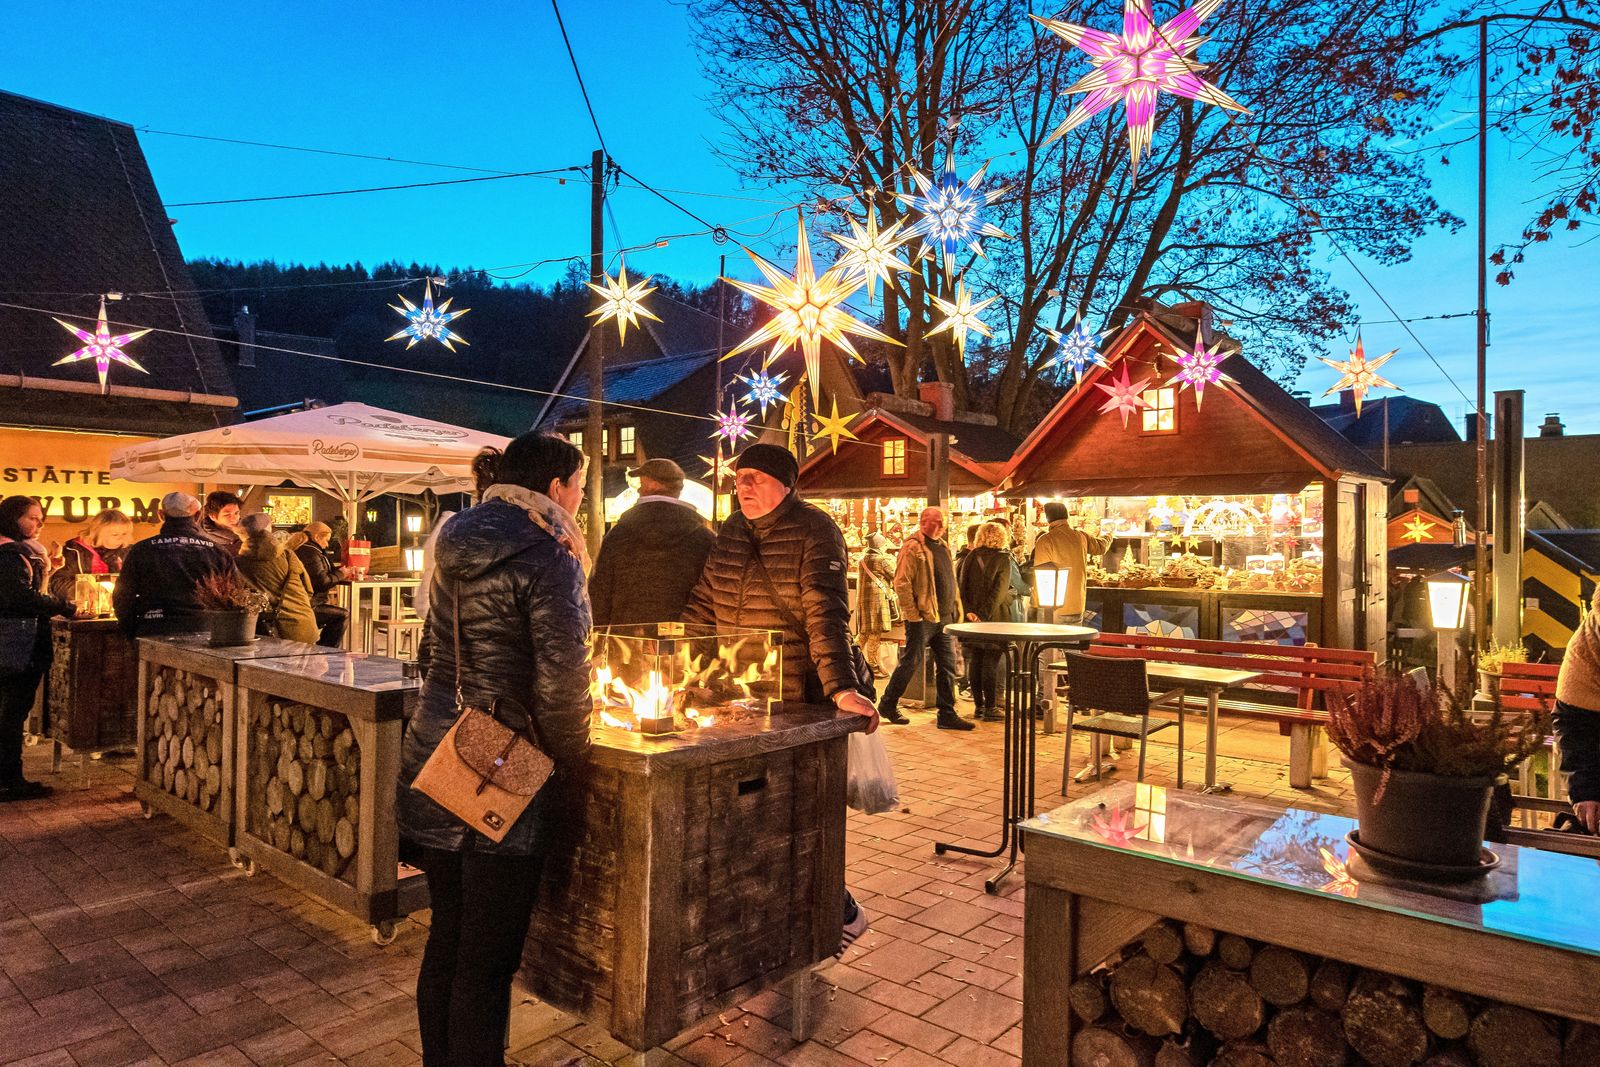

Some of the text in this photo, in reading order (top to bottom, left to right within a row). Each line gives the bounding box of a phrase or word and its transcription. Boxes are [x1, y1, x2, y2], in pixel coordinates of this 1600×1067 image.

[312, 439, 359, 461] Radeberger
[3, 466, 110, 485] STÄTTE
[189, 537, 214, 548] DAVID
